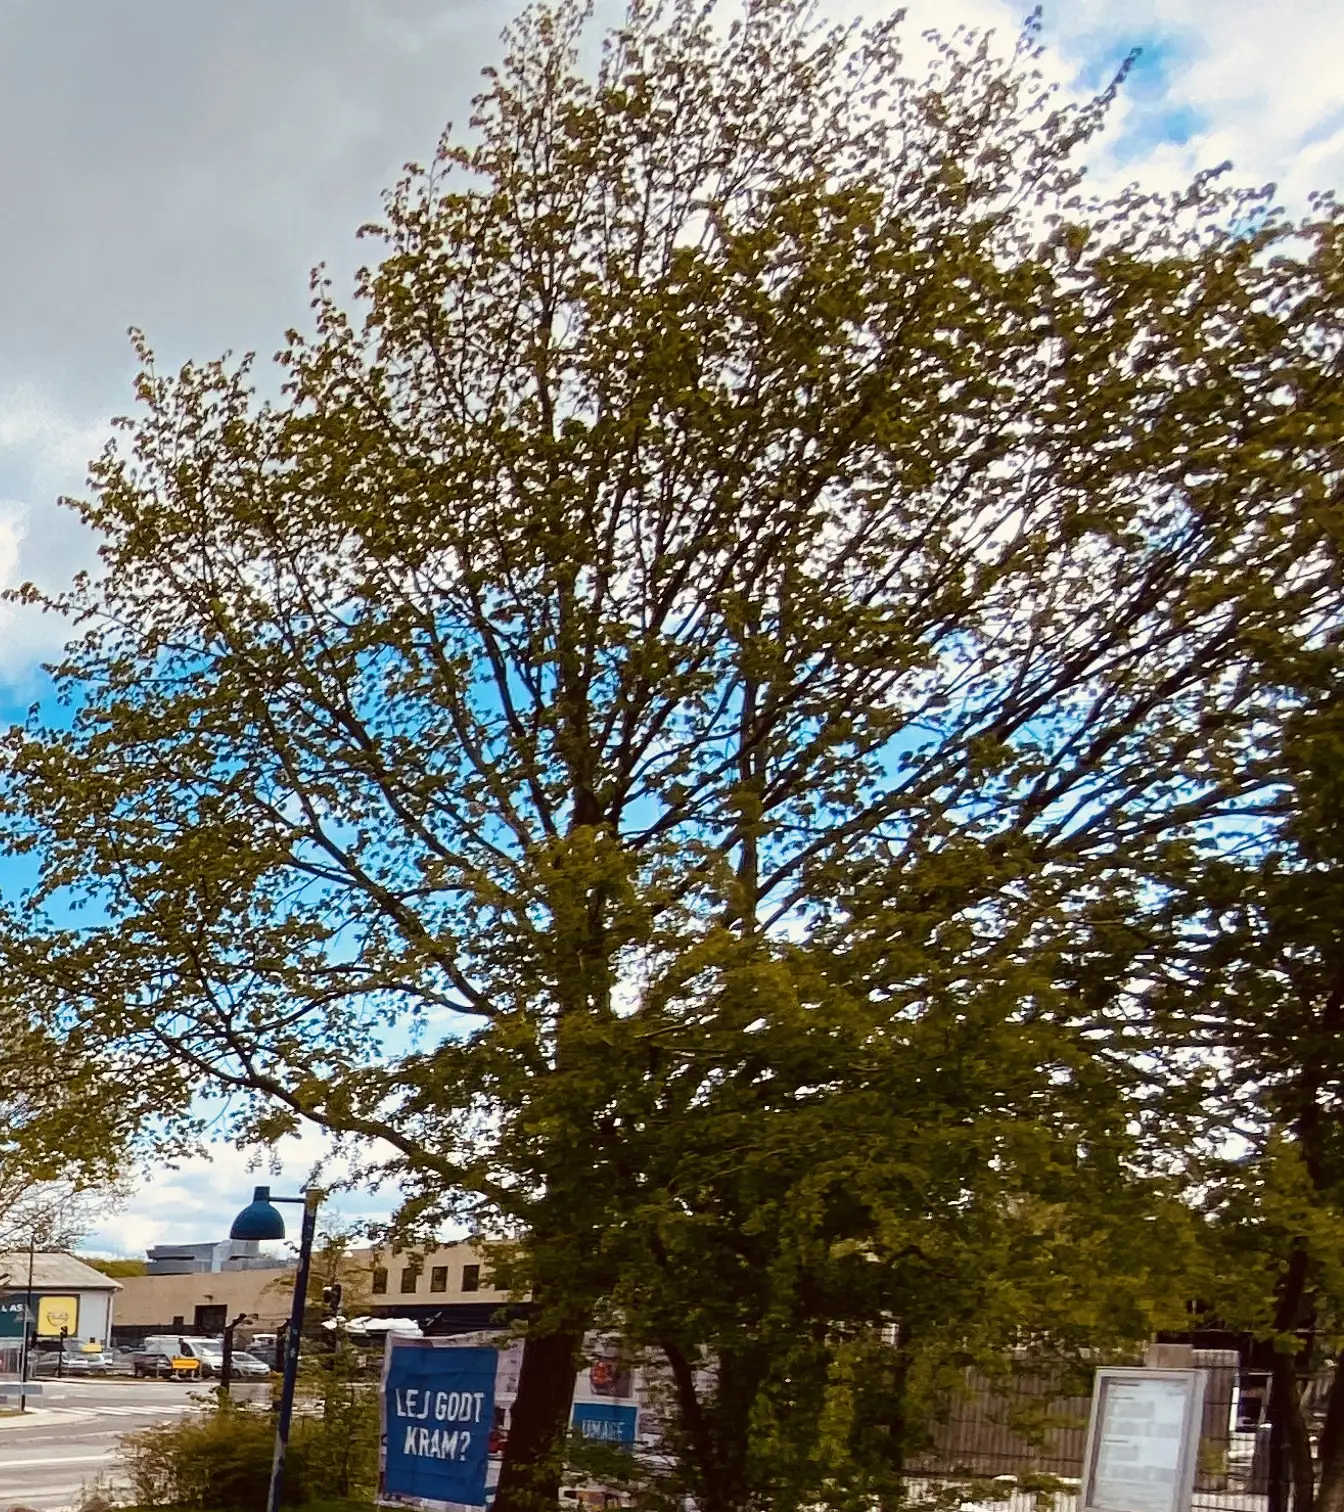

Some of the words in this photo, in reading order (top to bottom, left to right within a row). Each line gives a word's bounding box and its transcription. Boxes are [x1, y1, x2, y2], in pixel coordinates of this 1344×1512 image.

[395, 1388, 431, 1419] LEJ
[435, 1391, 485, 1423] GODT
[403, 1425, 471, 1462] KRAM?
